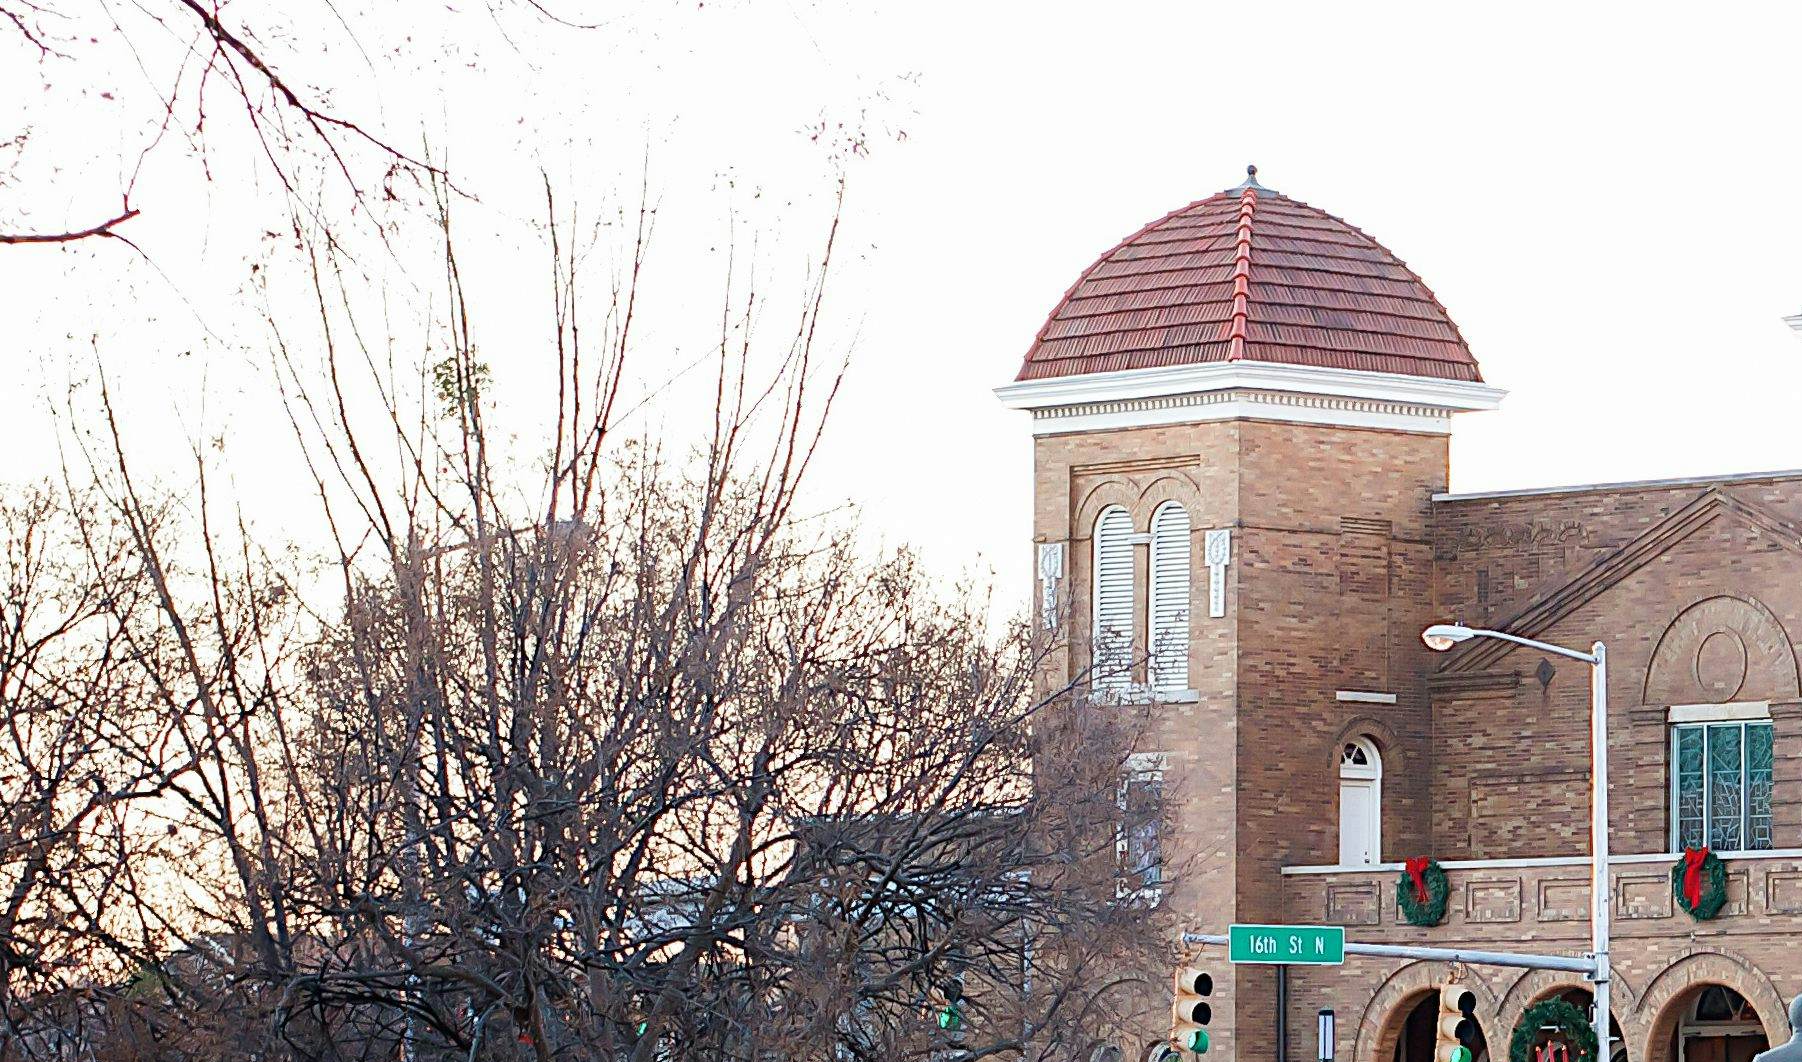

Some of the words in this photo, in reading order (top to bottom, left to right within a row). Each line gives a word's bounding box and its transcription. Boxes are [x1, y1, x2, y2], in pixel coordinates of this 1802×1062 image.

[1249, 934, 1277, 954] 16th
[1289, 935, 1303, 954] St
[1315, 936, 1324, 954] N
